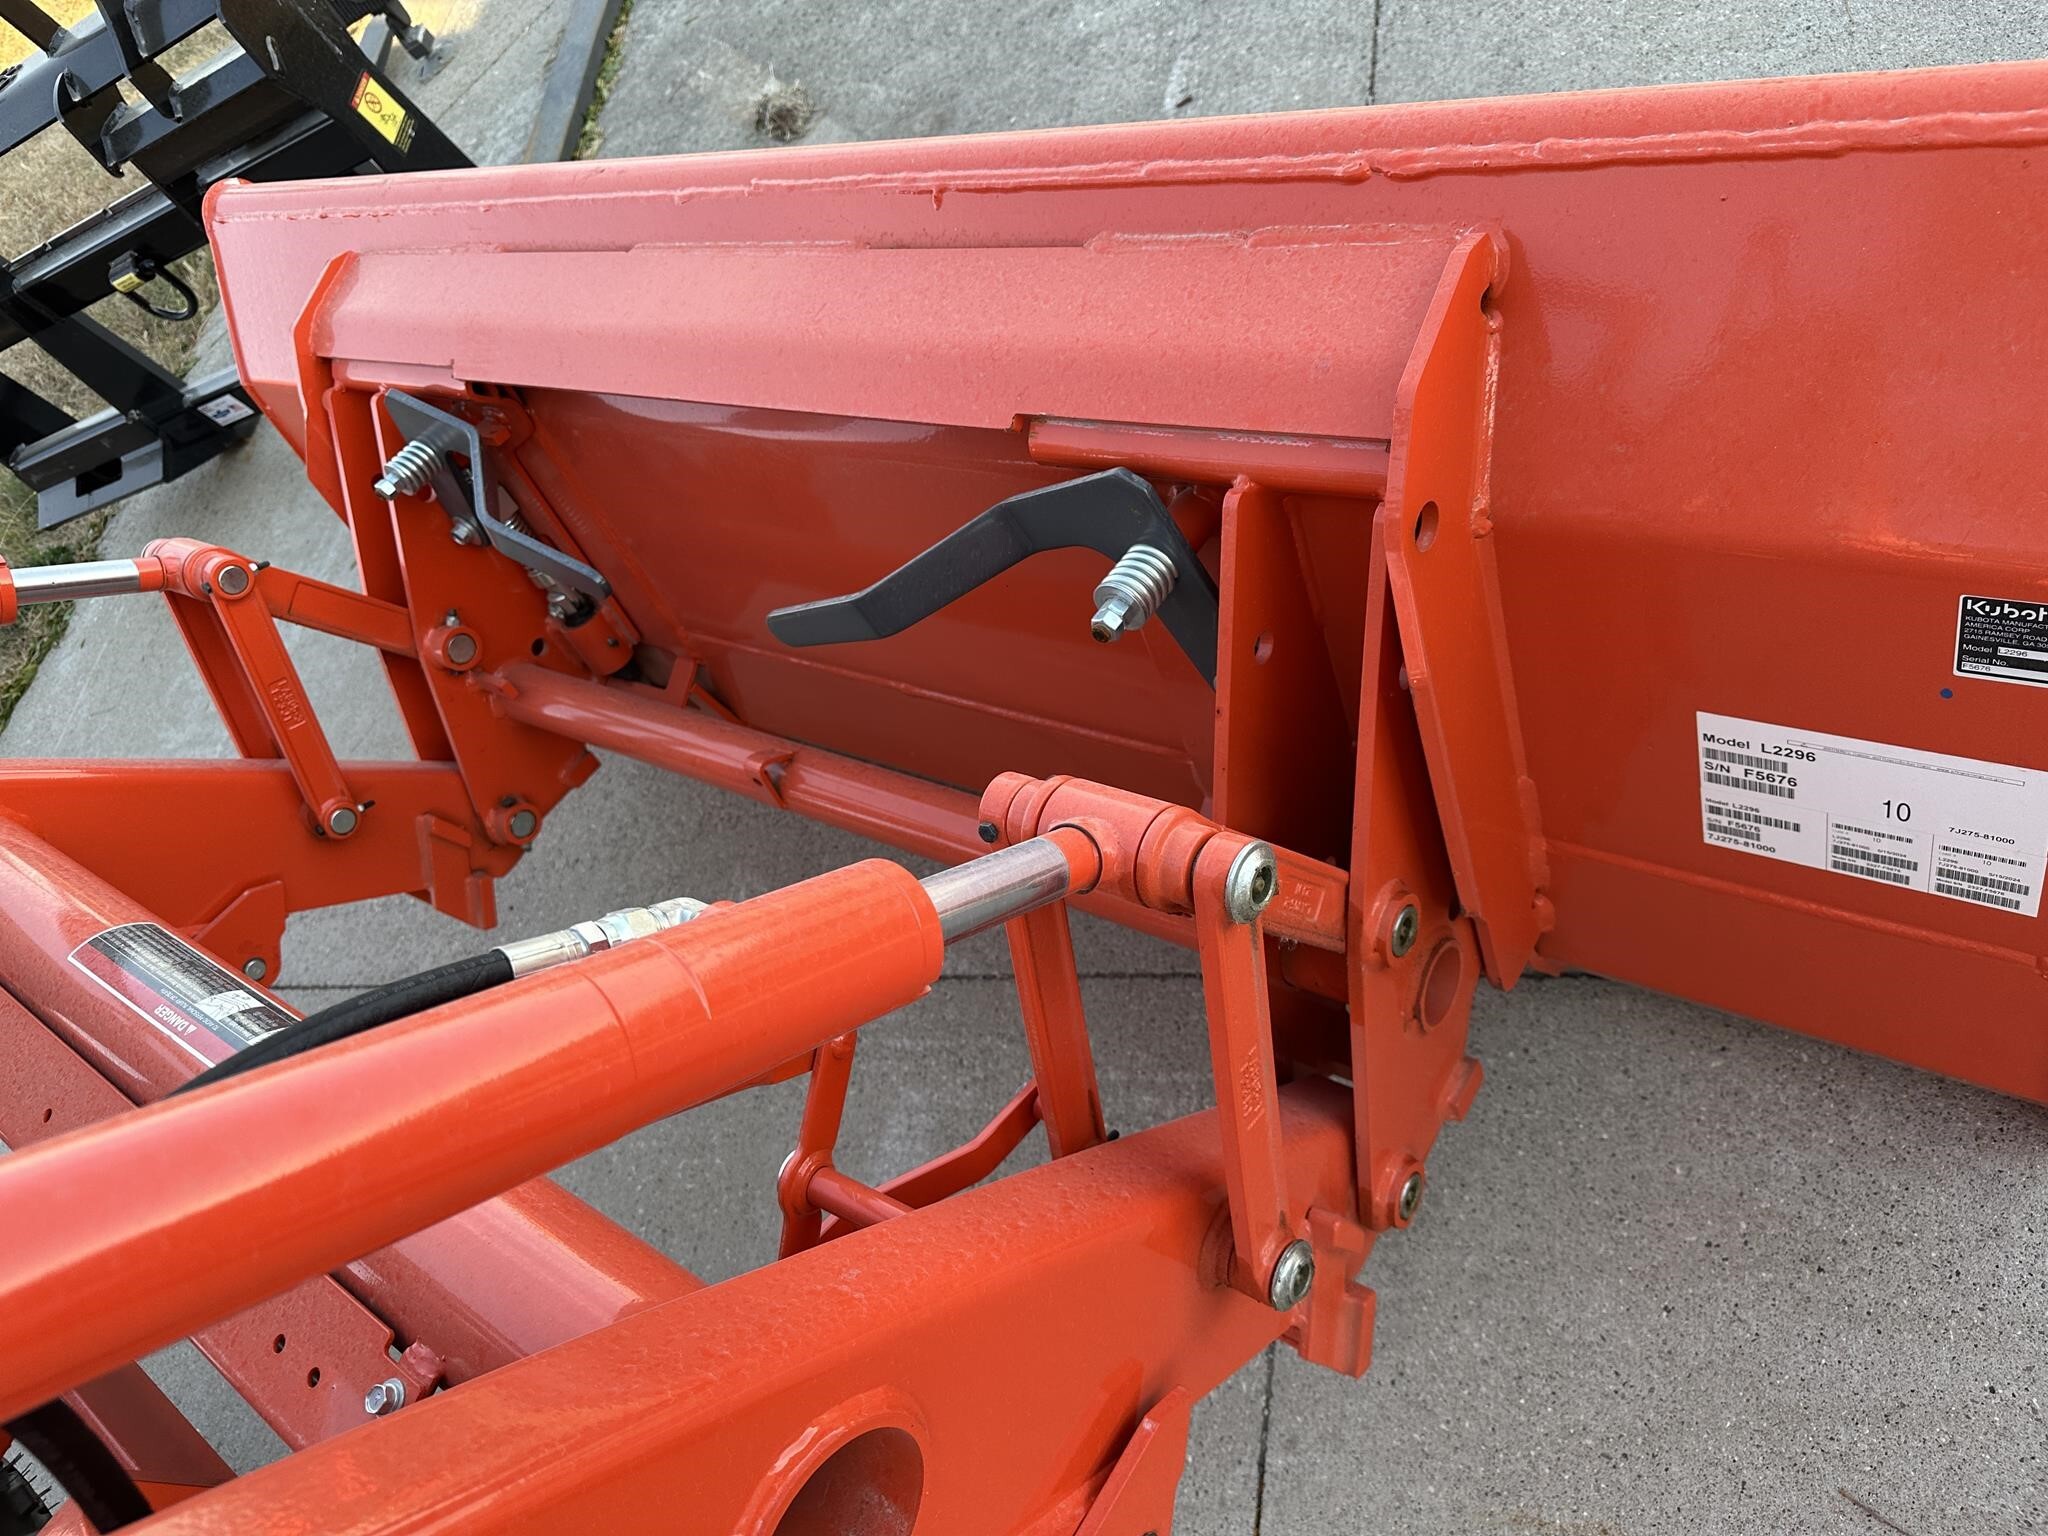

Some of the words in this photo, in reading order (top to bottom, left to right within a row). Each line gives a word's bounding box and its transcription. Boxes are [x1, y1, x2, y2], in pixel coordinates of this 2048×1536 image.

[1964, 622, 2003, 630] AMERICA
[1965, 616, 2000, 624] KUBOTA
[1985, 630, 2021, 638] RAMSEY
[1963, 644, 1992, 653] Model
[1998, 648, 2028, 657] L2296
[1962, 655, 1989, 663] Serial
[1963, 663, 1991, 671] F5676
[1702, 733, 1750, 750] Model
[1761, 743, 1816, 762] L2296
[1704, 761, 1731, 774] S/N
[1744, 768, 1798, 787] F5676
[1705, 797, 1729, 806] Model
[1732, 803, 1760, 813] L2296
[1882, 799, 1911, 822] 10
[1727, 820, 1760, 832] F5676
[1707, 832, 1776, 853] 7J275-81000
[1948, 826, 2015, 846] 7J275-81000
[154, 1003, 190, 1035] DANGER
